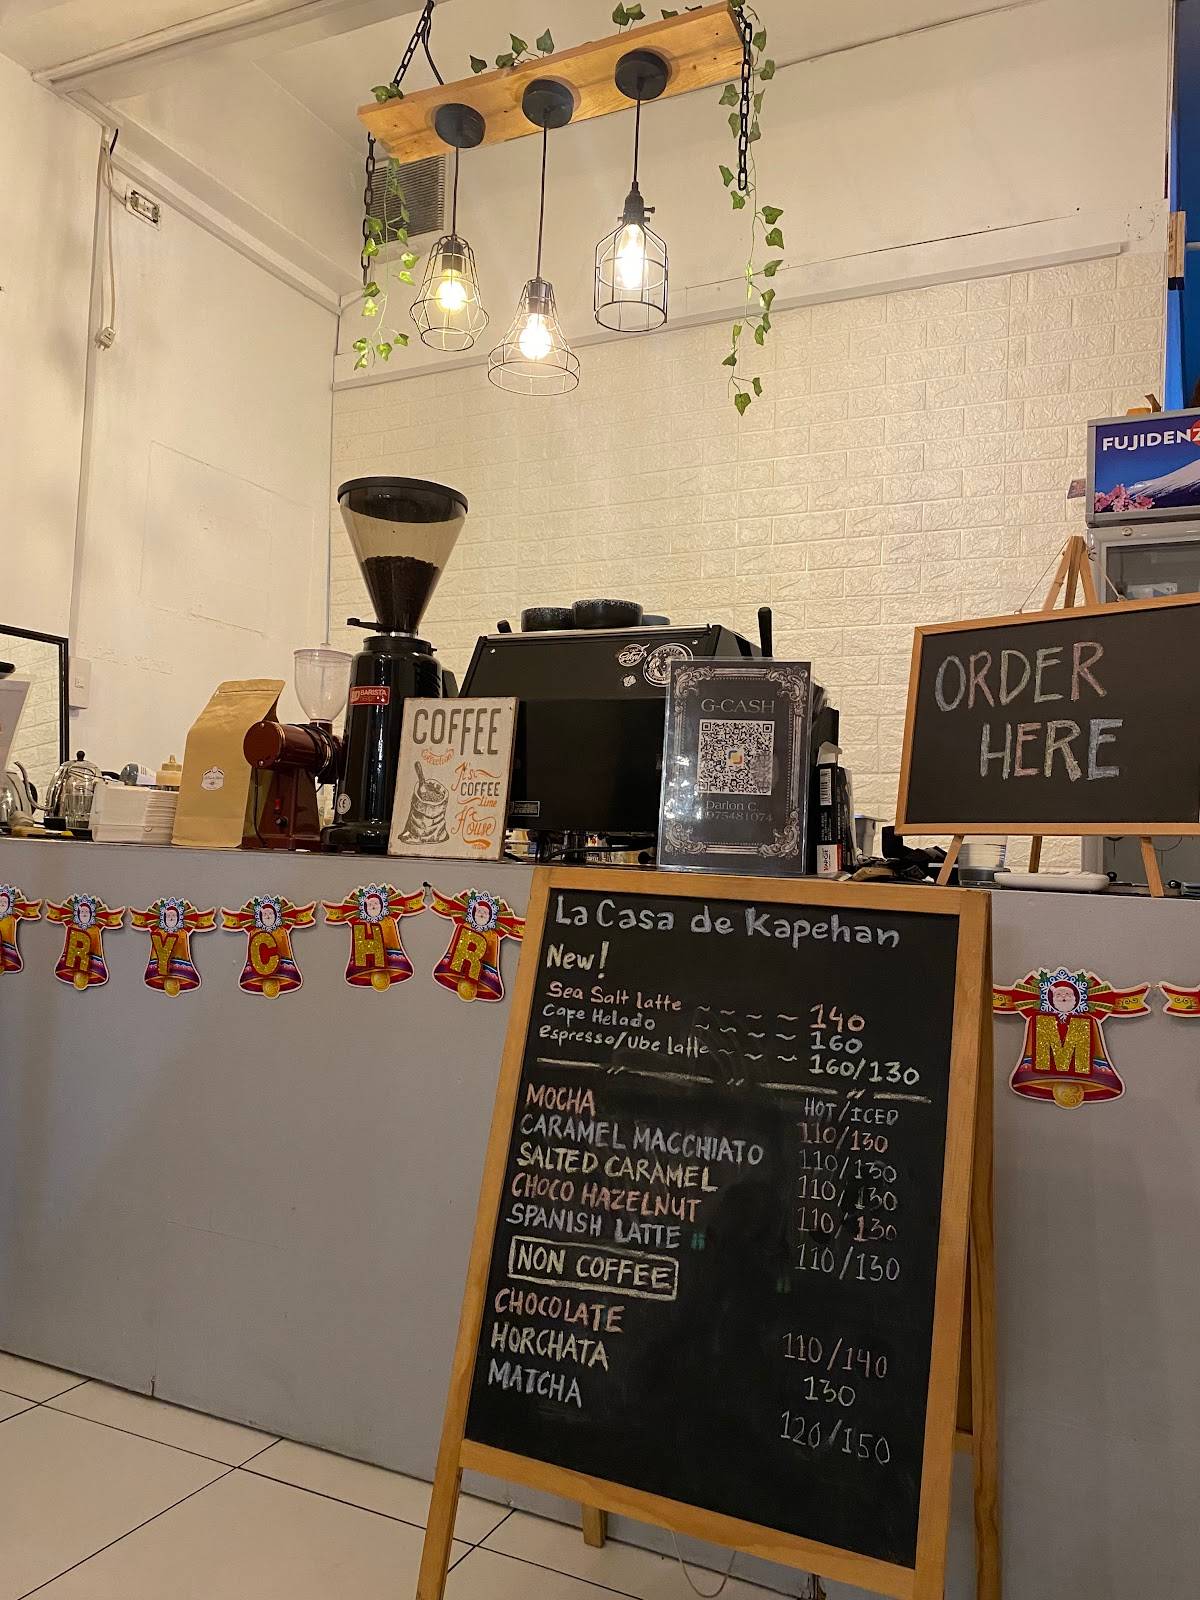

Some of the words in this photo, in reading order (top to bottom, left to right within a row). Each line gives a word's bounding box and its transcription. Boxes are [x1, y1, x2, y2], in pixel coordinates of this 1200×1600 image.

[935, 641, 1107, 711] ORDER
[700, 698, 775, 714] G-CASH
[412, 707, 502, 756] COFFEE
[980, 718, 1124, 782] HERE
[460, 781, 501, 797] COFFEE
[706, 800, 744, 811] Darlon
[555, 896, 587, 927] La
[596, 899, 674, 932] Casa
[690, 905, 735, 935] de
[745, 906, 900, 950] Kapehan
[65, 930, 92, 972] R
[151, 931, 177, 976] Y
[250, 931, 279, 975] C
[353, 924, 385, 967] H
[450, 928, 487, 981] R
[546, 940, 610, 980] New!
[547, 980, 584, 1001] Sea
[590, 985, 629, 1006] Salt
[808, 1003, 866, 1033] 140
[592, 1007, 656, 1031] Helado
[808, 1031, 863, 1054] 160
[1035, 1015, 1091, 1074] M
[807, 1055, 921, 1085] 160/130
[526, 1083, 596, 1117] MOCHA
[521, 1113, 626, 1149] CARAMEL
[632, 1126, 764, 1165] MACCHIATO
[516, 1141, 599, 1170] SALTED
[604, 1154, 719, 1192] CARAMEL
[511, 1172, 575, 1202] CHOCO
[582, 1186, 702, 1223] HAZELNUT
[505, 1200, 602, 1237] SPANISH
[614, 1218, 682, 1250] LATTE
[516, 1243, 566, 1275] NON
[576, 1254, 673, 1289] COFFEE
[494, 1287, 625, 1334] CHOCOLATE
[490, 1322, 610, 1371] HORCHATA
[781, 1332, 888, 1379] 110/140
[487, 1358, 583, 1408] MATCHA
[803, 1375, 856, 1408] 130
[779, 1410, 891, 1465] 120/150
